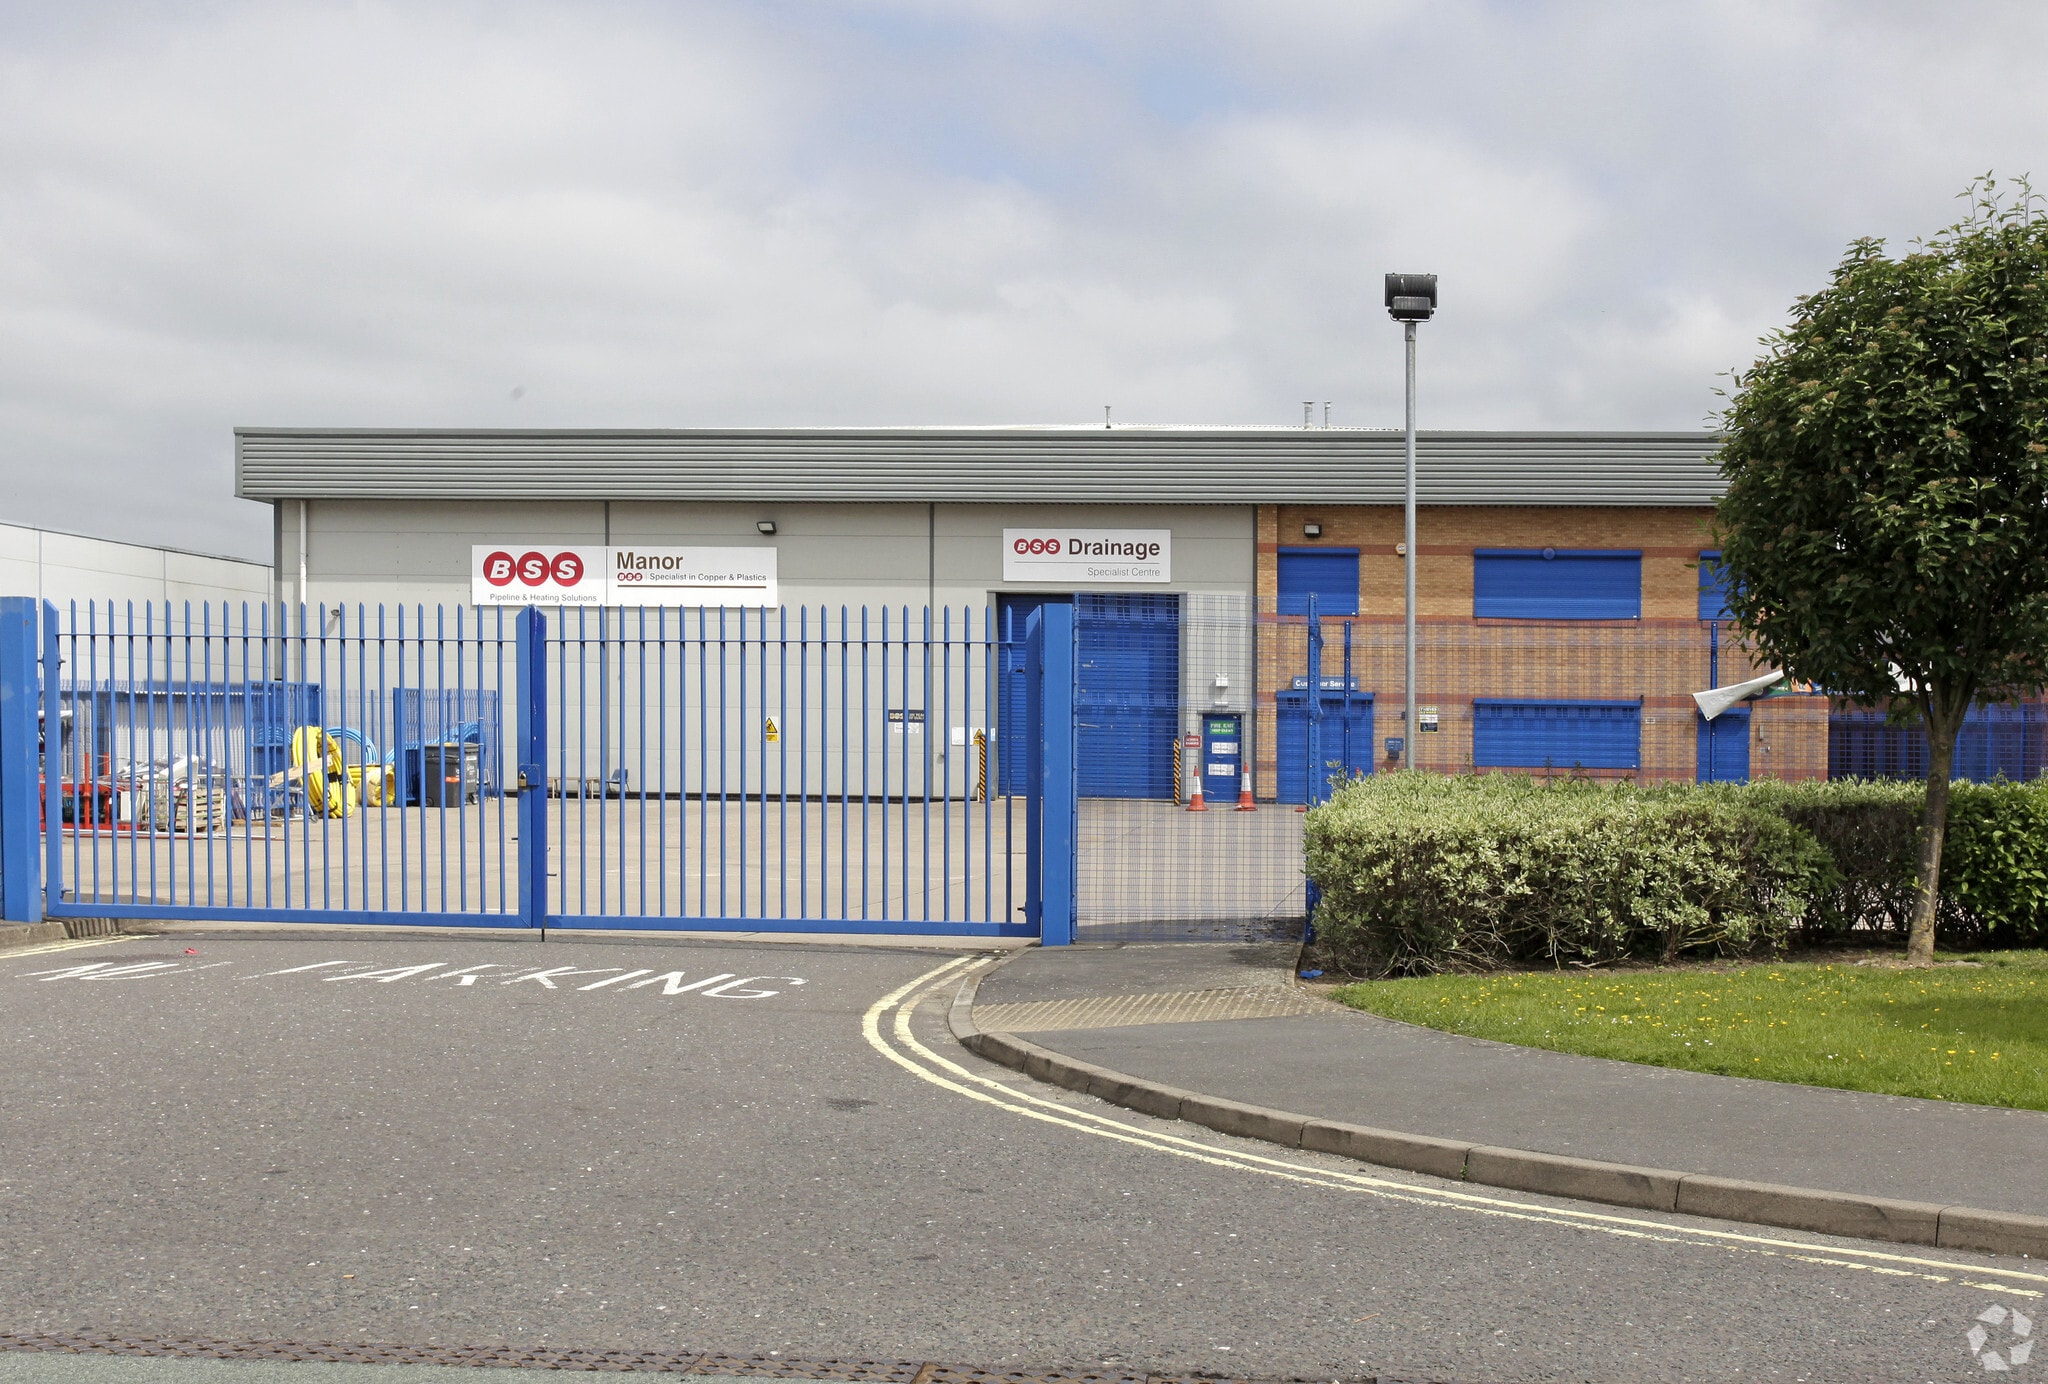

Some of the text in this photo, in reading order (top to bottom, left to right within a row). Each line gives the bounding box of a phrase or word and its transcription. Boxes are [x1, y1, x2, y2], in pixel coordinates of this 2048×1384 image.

[1016, 538, 1160, 560] BSS Drainage
[488, 557, 579, 581] BSS
[617, 551, 684, 570] Manor
[617, 573, 643, 581] BSS
[649, 573, 687, 581] Specialist
[698, 573, 727, 582] Copper
[736, 573, 767, 581] Plastics
[1087, 567, 1161, 577] Specialist Centre
[489, 593, 520, 602] Pipeline
[530, 594, 559, 603] Heating
[561, 594, 597, 602] Solutions
[231, 959, 810, 1000] PARKING
